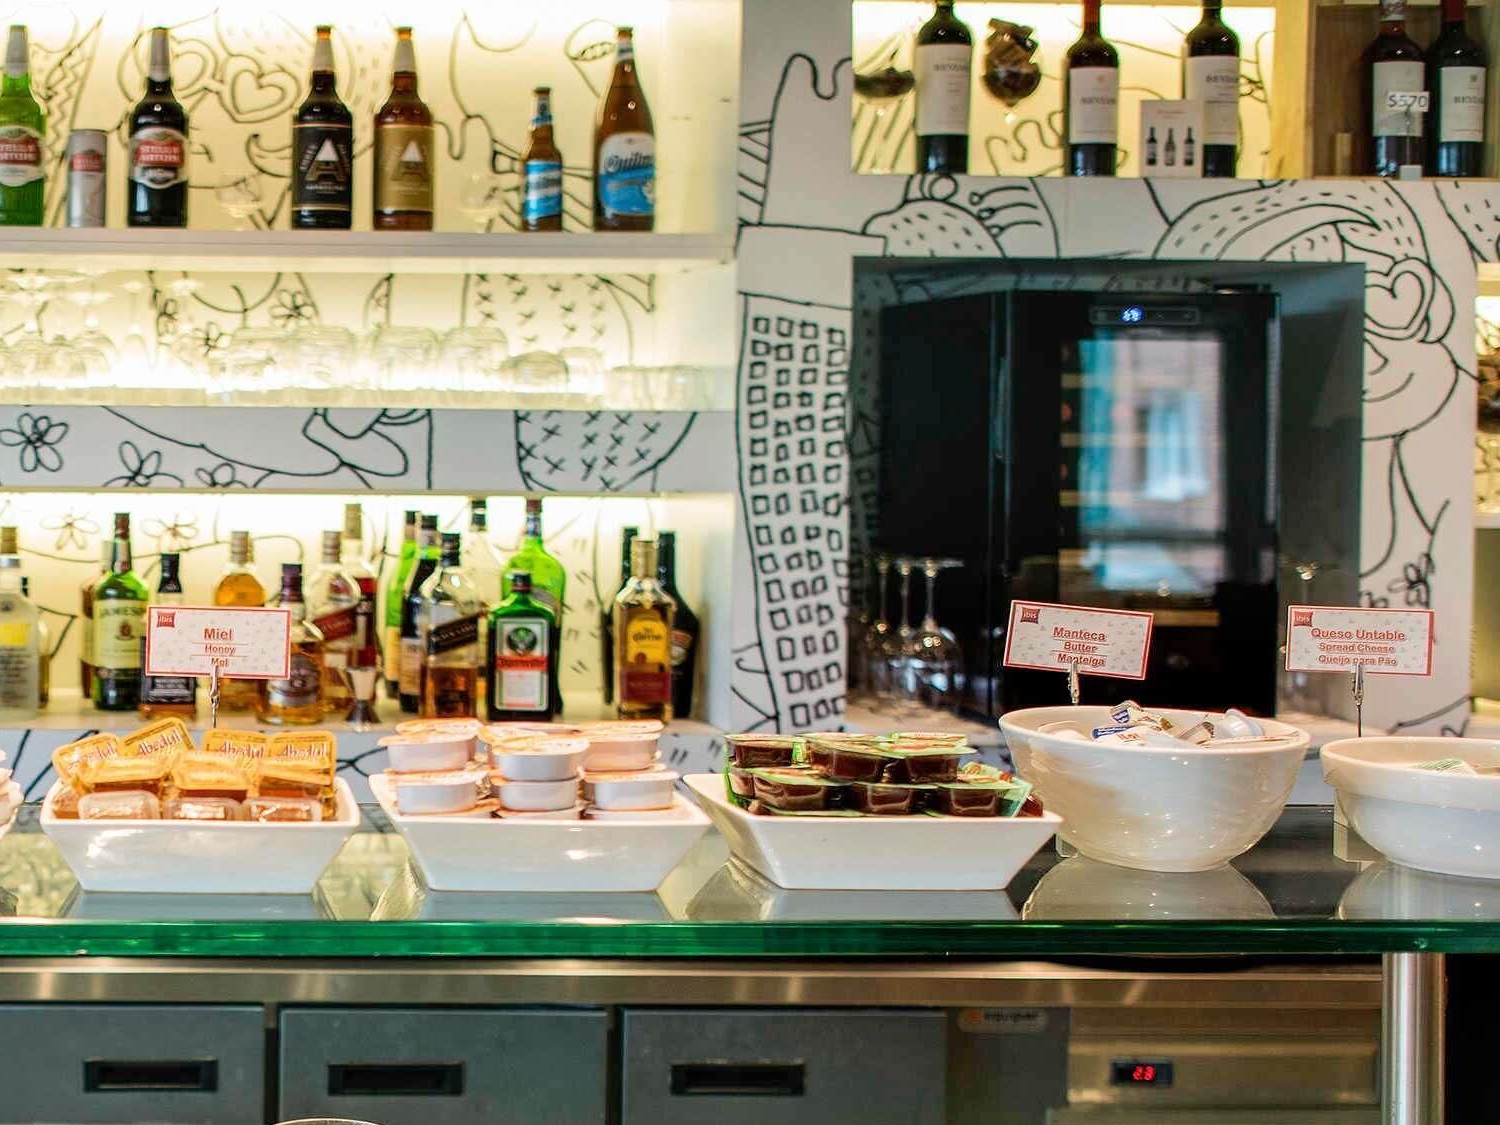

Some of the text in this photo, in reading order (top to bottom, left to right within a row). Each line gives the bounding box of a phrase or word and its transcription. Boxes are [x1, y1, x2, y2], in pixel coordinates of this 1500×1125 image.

[204, 628, 233, 640] Miel
[1053, 627, 1107, 641] Manteca
[1311, 628, 1406, 641] Queso Untable
[205, 644, 236, 656] Honey
[1064, 641, 1099, 653] Butter
[1319, 642, 1396, 654] Spread Cheese
[211, 658, 229, 667] Mel
[1057, 653, 1107, 668] Manteiga
[1318, 654, 1397, 666] Queijo para Pão
